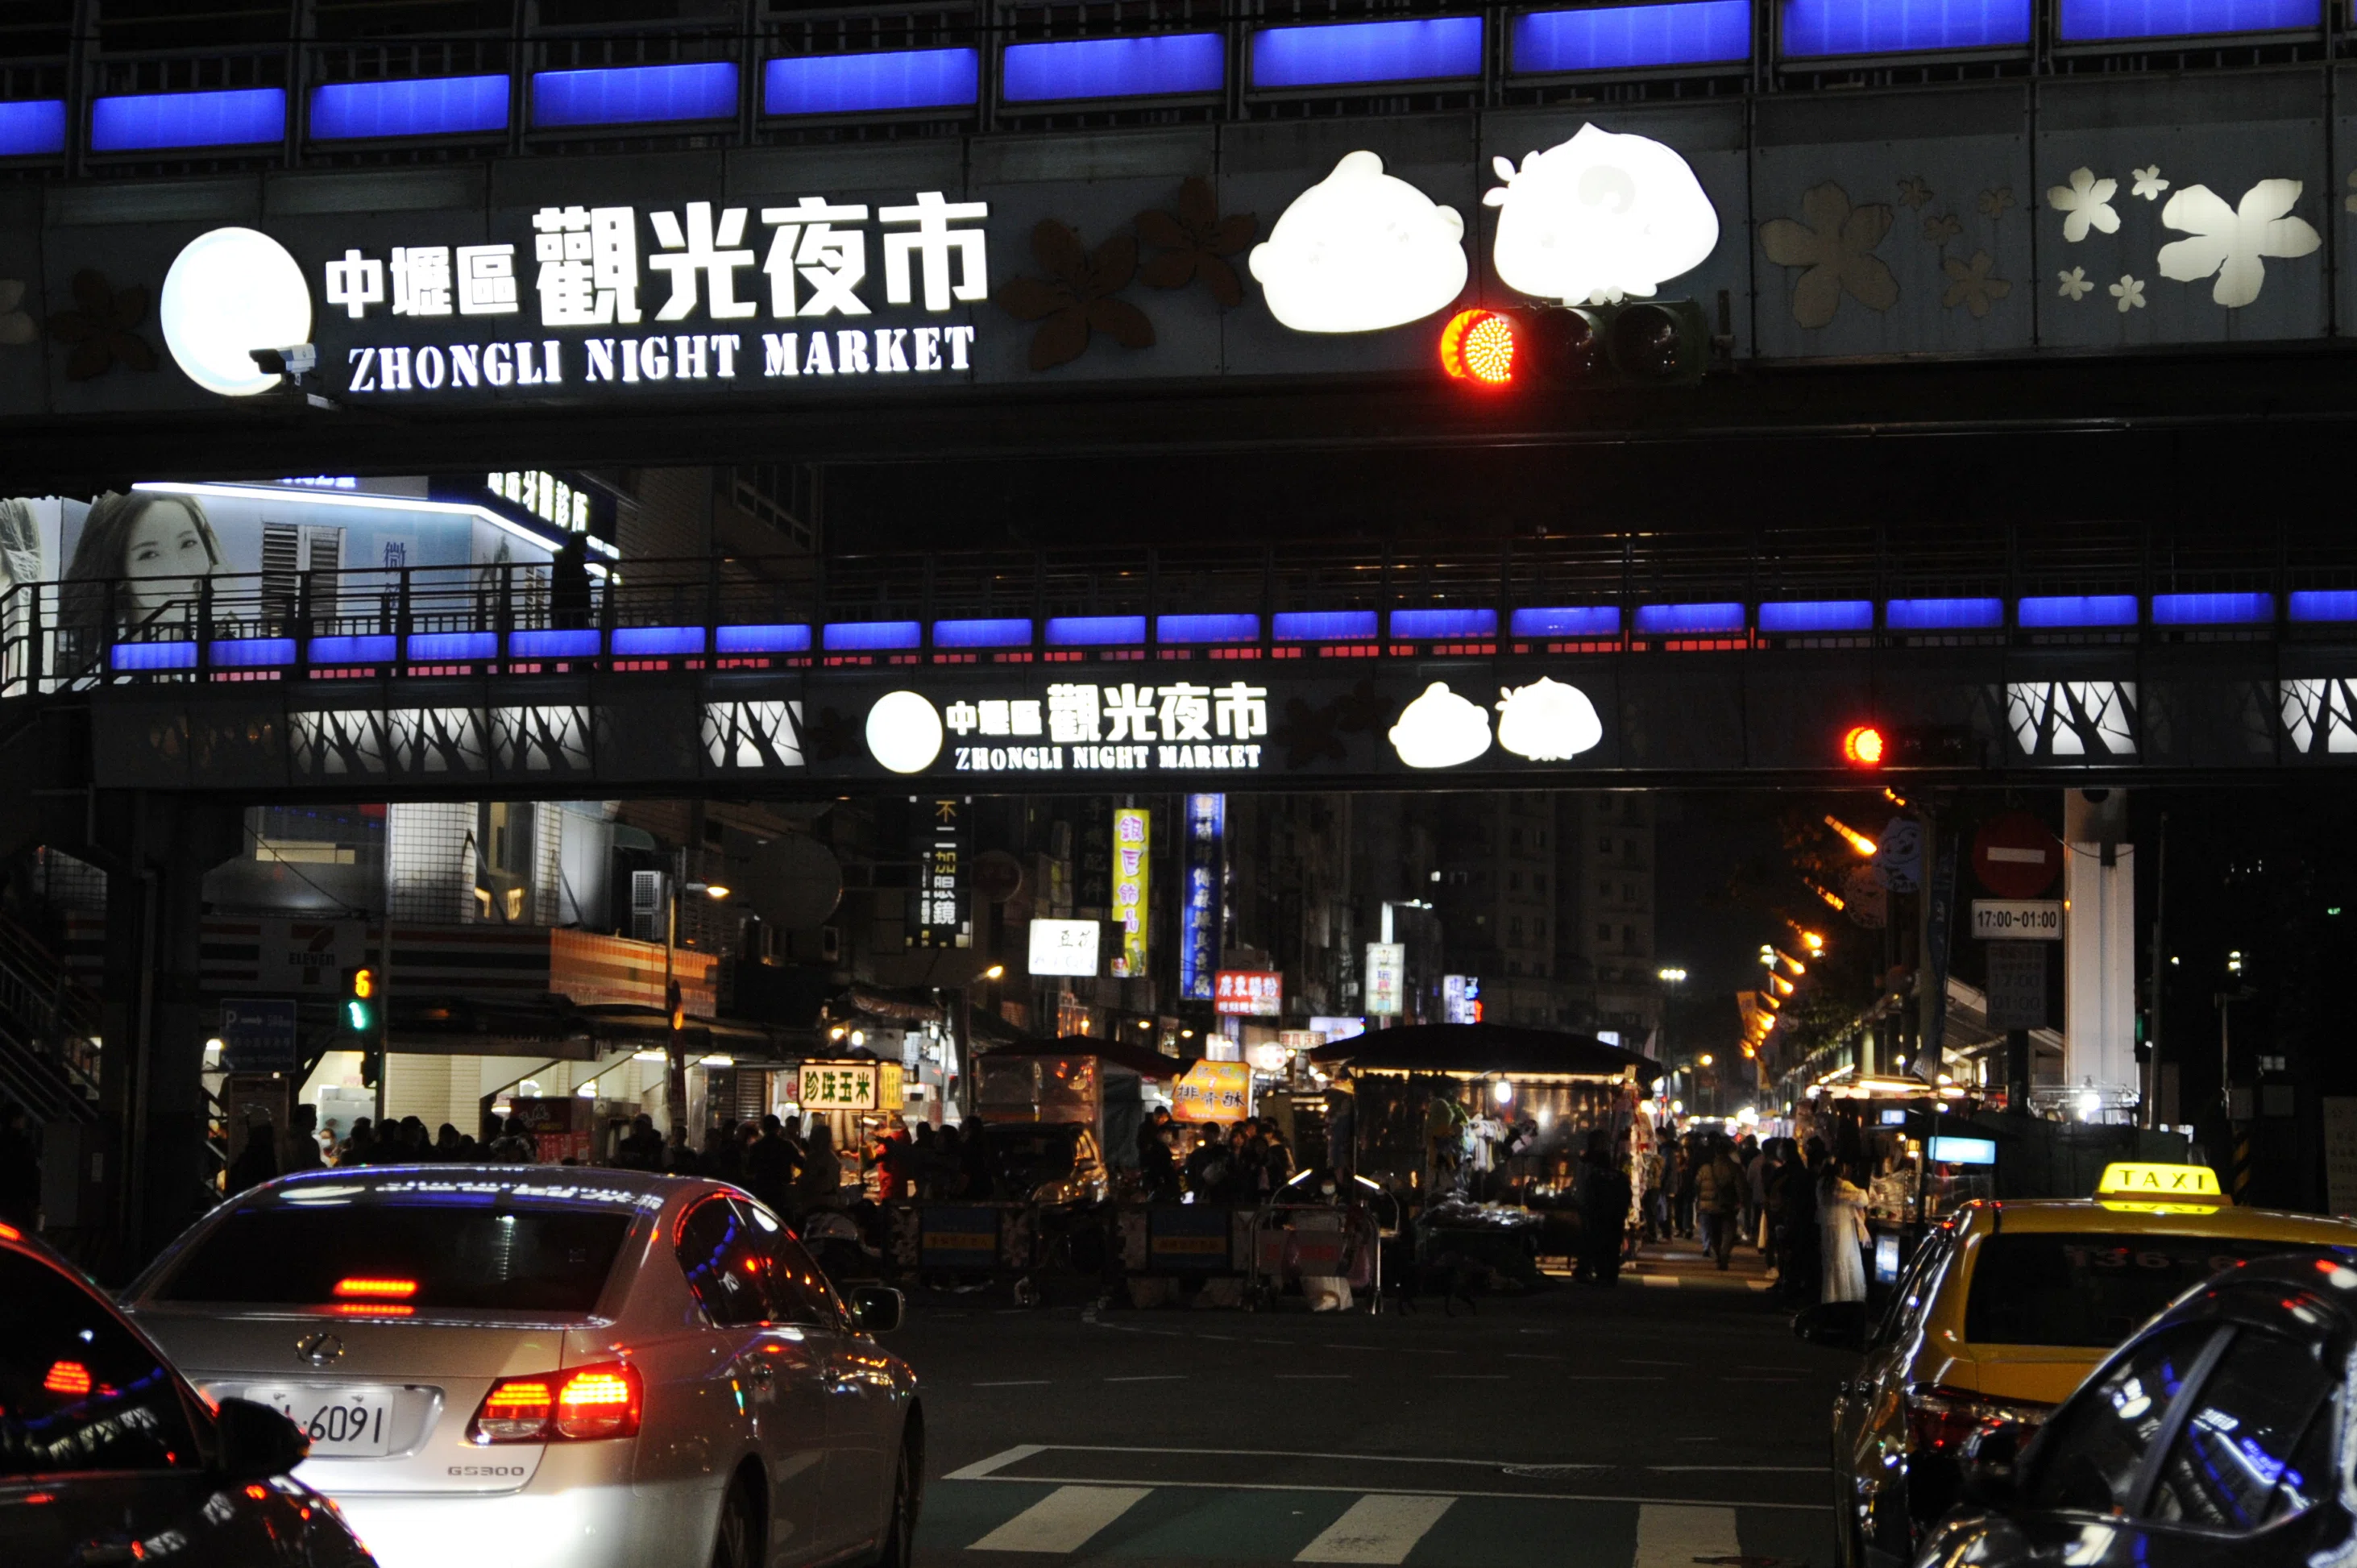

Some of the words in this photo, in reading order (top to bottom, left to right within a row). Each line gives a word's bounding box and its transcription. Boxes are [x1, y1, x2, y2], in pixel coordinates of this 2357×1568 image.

[325, 191, 988, 326] 中壢區觀光夜市
[347, 341, 562, 392] ZHONGLI
[584, 334, 741, 383] NIGHT
[762, 326, 975, 377] MARKET
[955, 746, 1064, 771] ZHONGLI
[1072, 745, 1149, 770] NIGHT
[1158, 744, 1262, 769] MARKET
[1977, 910, 2056, 928] 17:00~01:00
[355, 969, 372, 998] 6
[803, 1070, 870, 1104] 珍珠玉米
[2118, 1169, 2204, 1190] TAXI
[447, 1466, 525, 1476] GS300
